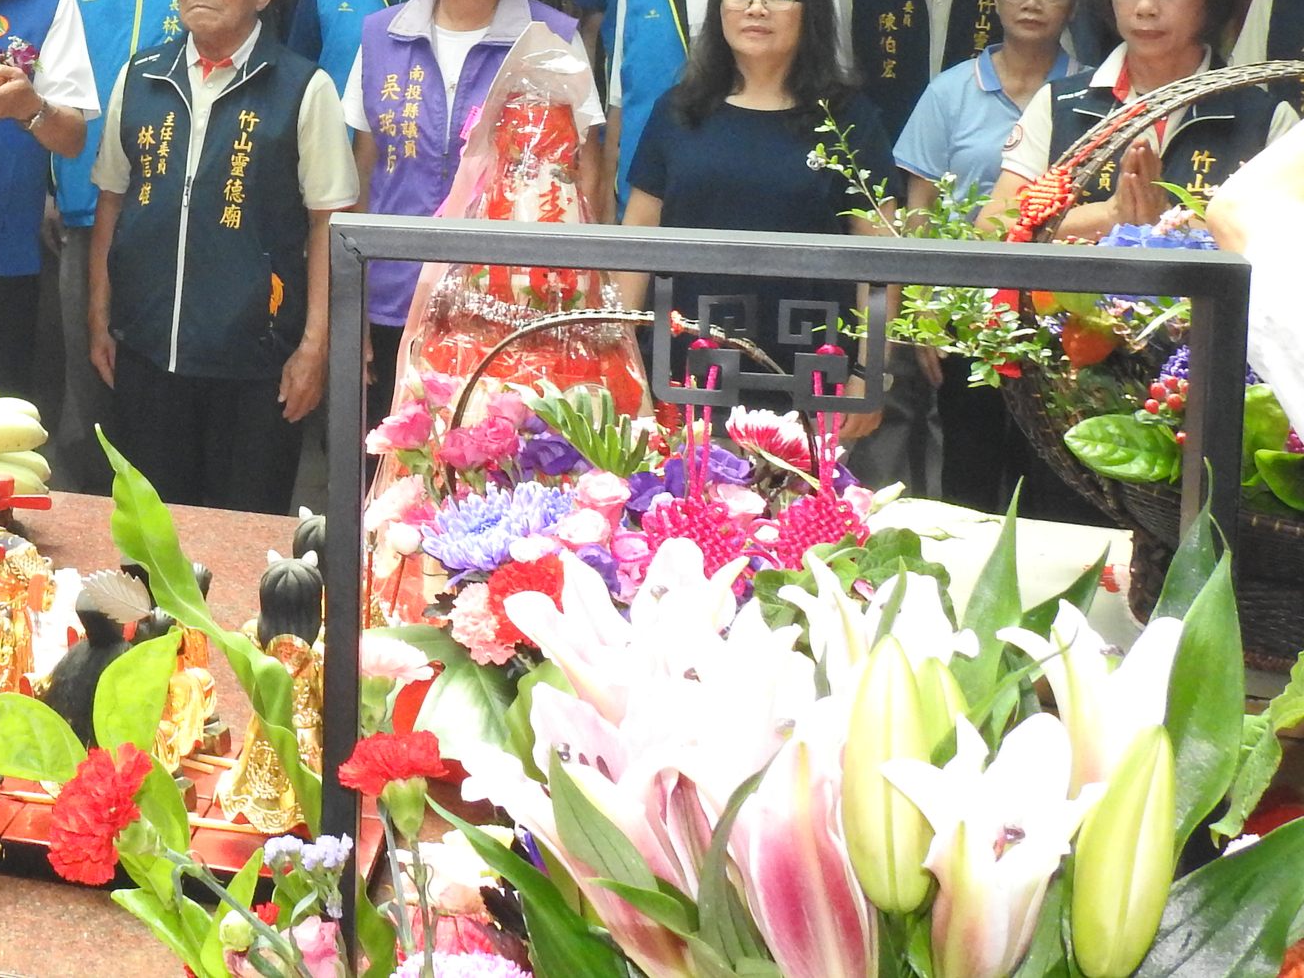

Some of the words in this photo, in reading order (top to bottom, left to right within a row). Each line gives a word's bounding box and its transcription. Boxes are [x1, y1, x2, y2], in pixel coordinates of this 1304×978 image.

[156, 111, 175, 174] 主任委員
[400, 64, 424, 158] 南投縣議員
[219, 109, 260, 229] 竹山靈德廟
[1186, 149, 1217, 206] 竹山
